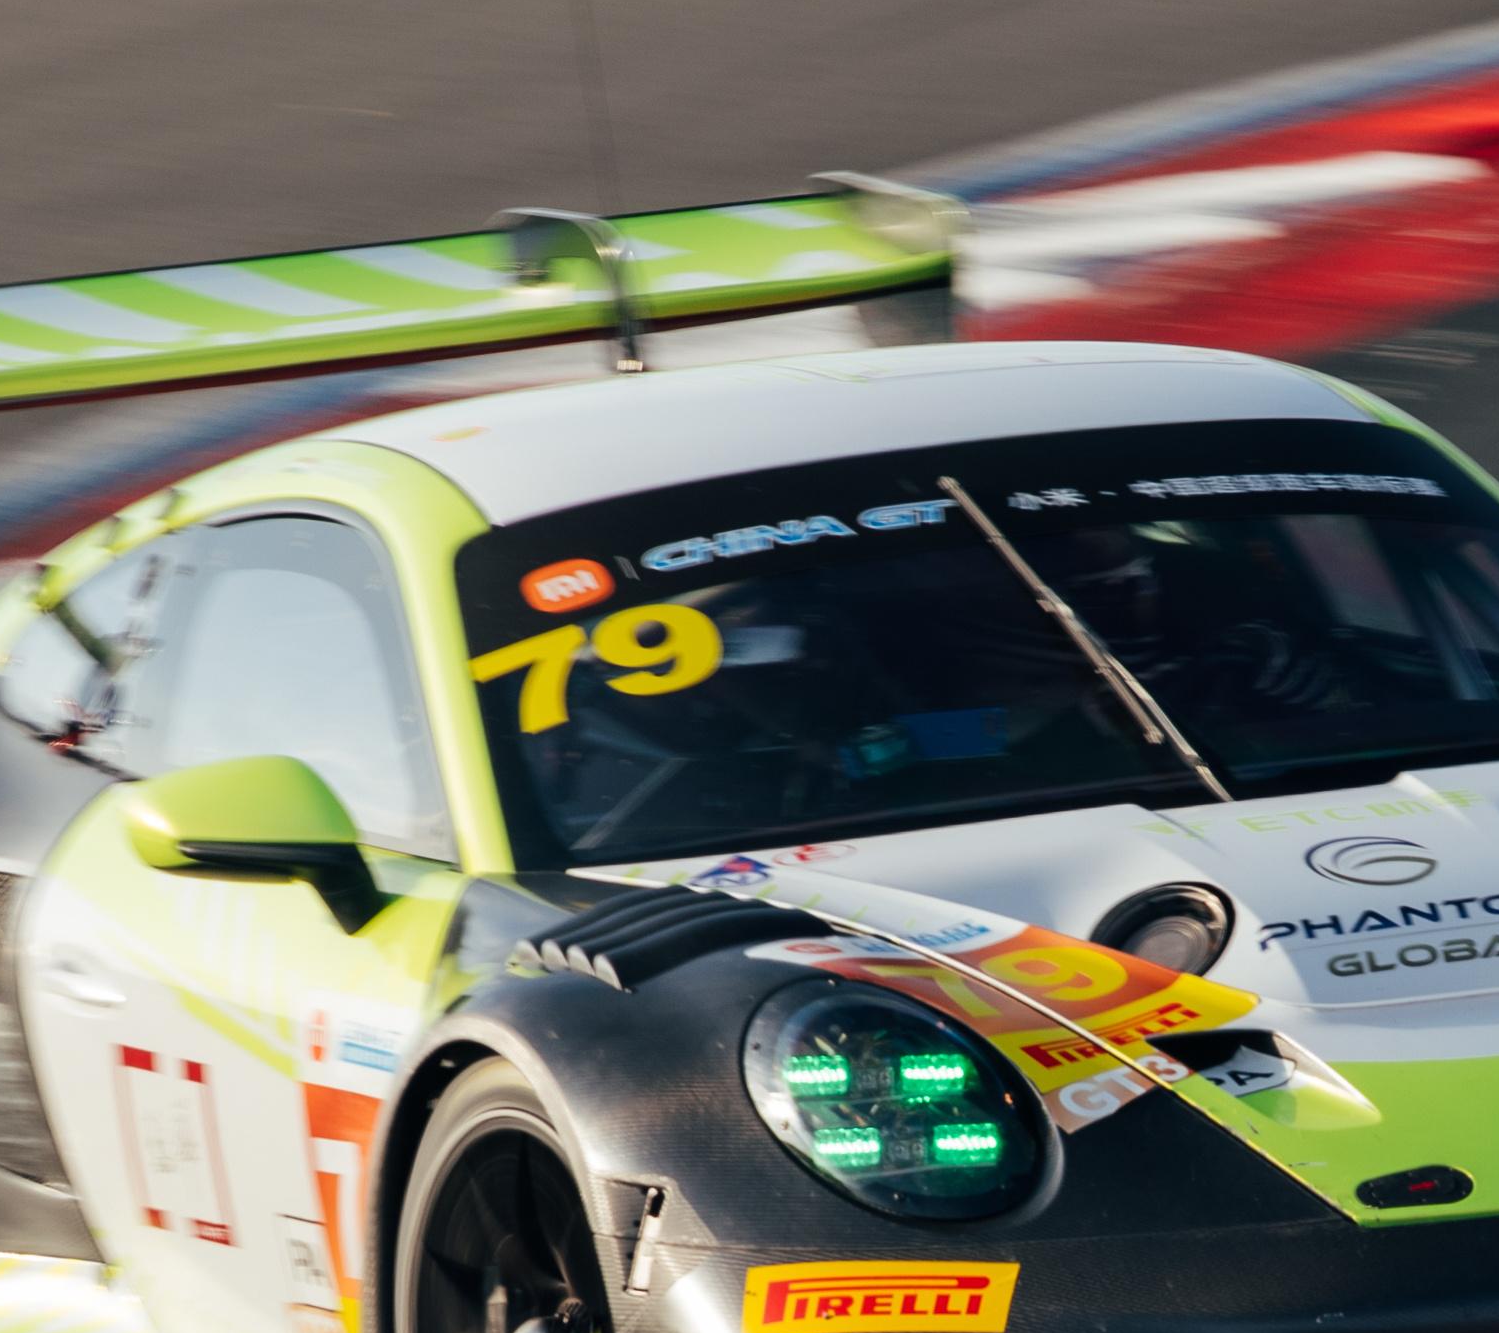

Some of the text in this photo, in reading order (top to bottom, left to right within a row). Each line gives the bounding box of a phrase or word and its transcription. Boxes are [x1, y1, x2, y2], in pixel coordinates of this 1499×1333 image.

[469, 602, 724, 734] 79
[862, 945, 1129, 1018] 79
[1020, 1002, 1202, 1070] PIRELLI
[1058, 1054, 1190, 1120] GT3
[762, 1274, 991, 1326] PIRELLI
